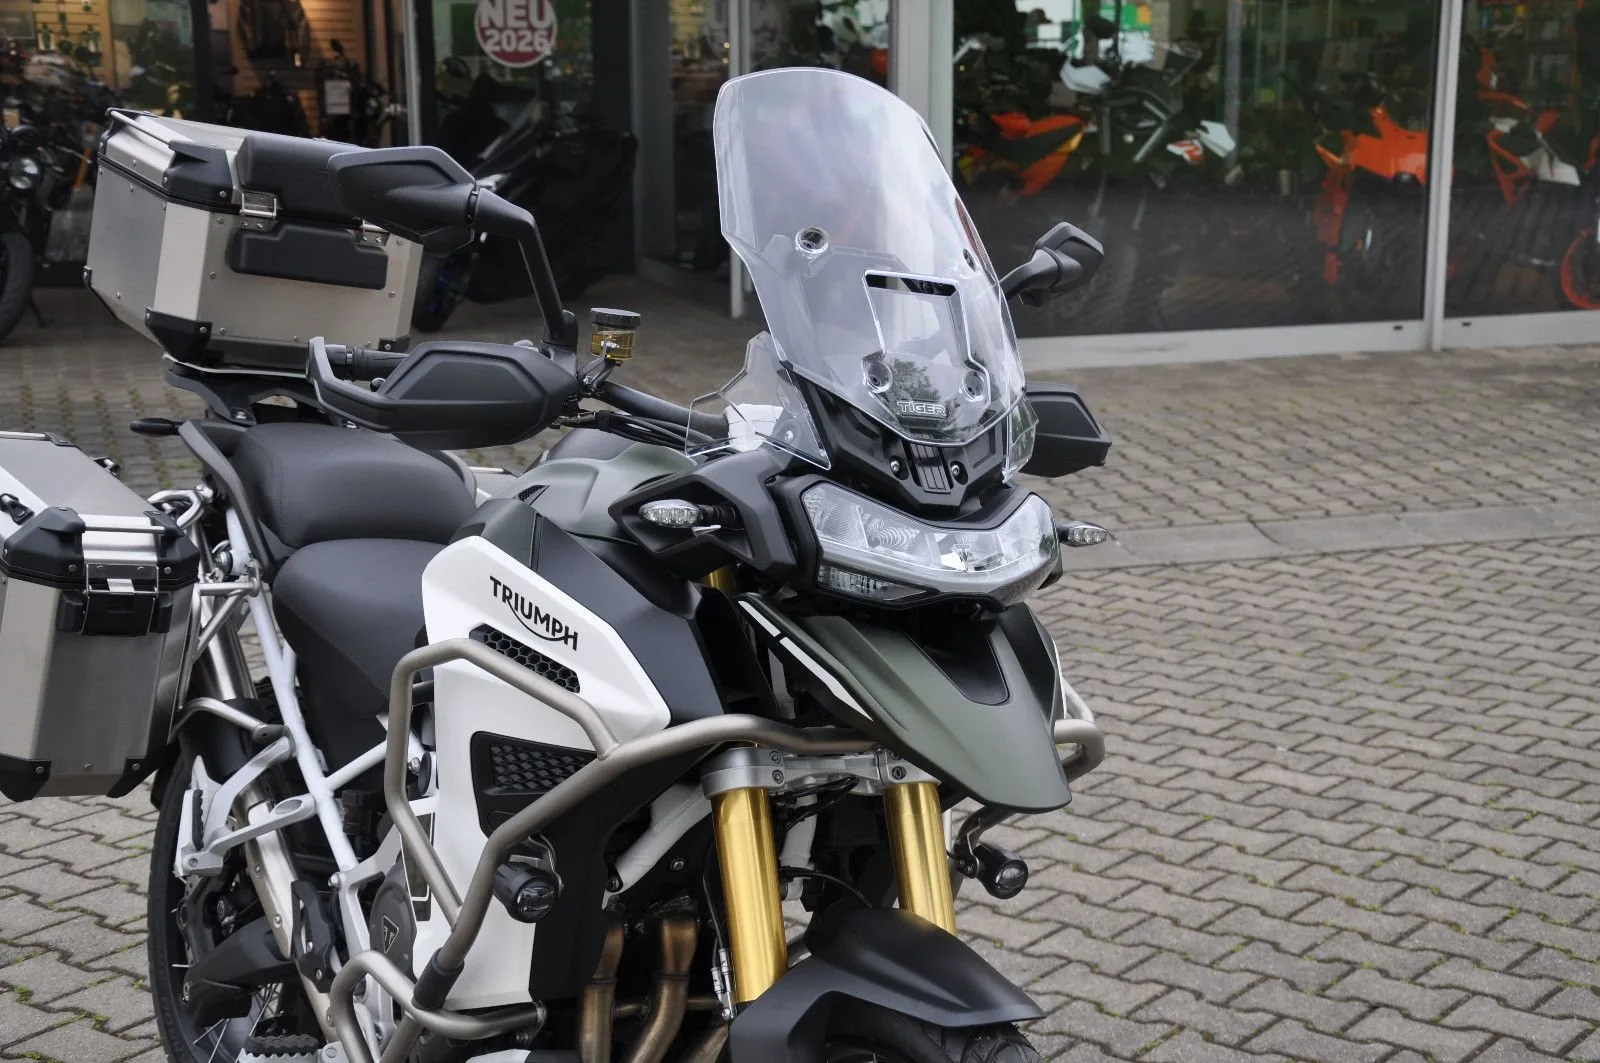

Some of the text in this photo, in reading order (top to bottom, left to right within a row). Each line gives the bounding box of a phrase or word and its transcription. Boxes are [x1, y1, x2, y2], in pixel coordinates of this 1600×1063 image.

[479, 0, 551, 28] NEU
[484, 28, 552, 53] 2026
[897, 401, 947, 417] TIGER
[489, 575, 579, 651] TRIUMPH
